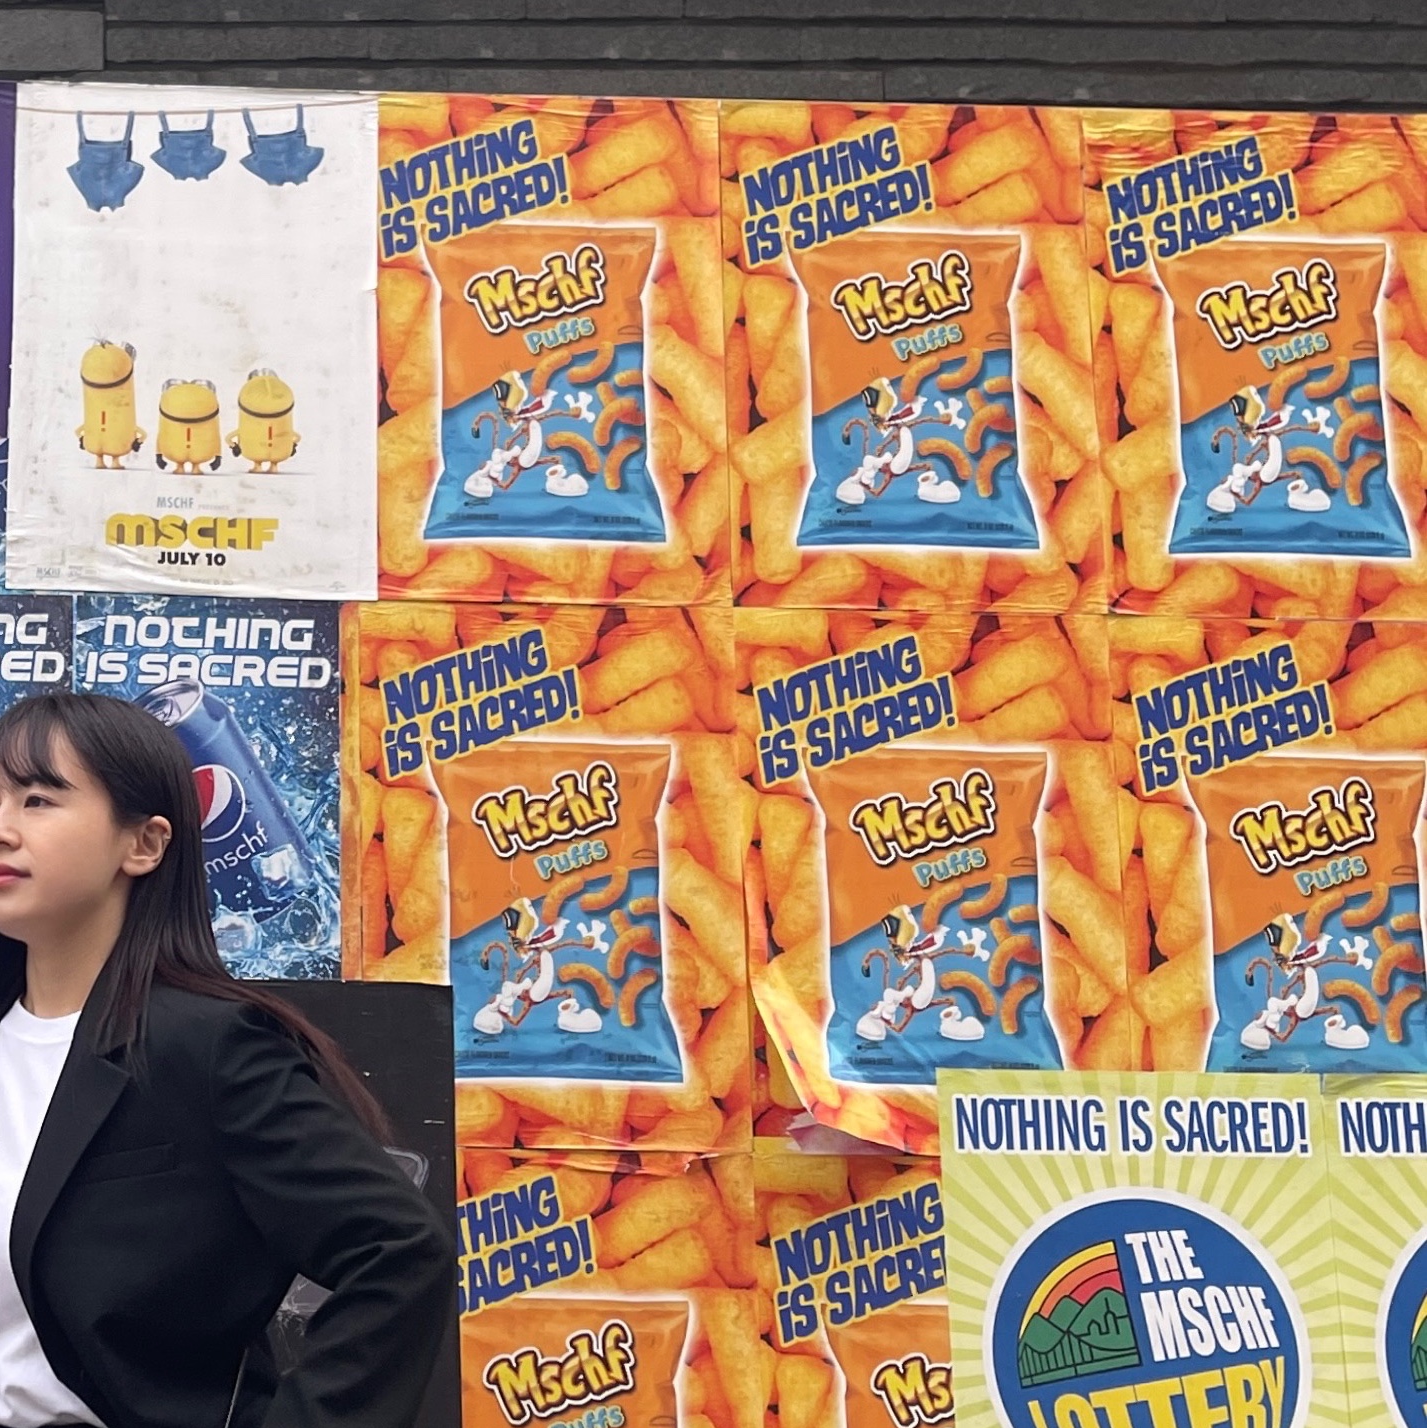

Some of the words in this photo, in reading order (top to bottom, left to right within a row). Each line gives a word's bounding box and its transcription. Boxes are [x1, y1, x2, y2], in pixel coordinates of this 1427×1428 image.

[425, 155, 570, 243] SACRED!
[789, 163, 934, 250] SACRED!
[1153, 174, 1296, 259] SACRED!
[466, 246, 605, 331] Mschf
[833, 253, 971, 337] Mschf
[1198, 260, 1337, 347] Mschf
[525, 317, 596, 355] Puffs
[891, 325, 964, 361] Puffs
[1259, 332, 1330, 369] Puffs
[157, 496, 194, 509] MSCHF
[157, 551, 201, 567] JULY
[205, 553, 227, 567] 10
[84, 651, 127, 685] IS
[137, 652, 332, 689] SACRED
[430, 668, 580, 762] SACRED!
[805, 674, 956, 768] SACRED!
[1184, 682, 1334, 777] SACRED!
[204, 820, 268, 875] mschf
[474, 762, 617, 855] Mschf
[851, 770, 995, 862] Mschf
[1231, 778, 1373, 870] Mschf
[534, 840, 609, 880] Puffs
[913, 847, 987, 887] Puffs
[1294, 855, 1368, 896] Puffs
[955, 1098, 1106, 1152] NOTHING
[1121, 1099, 1153, 1152] IS
[1165, 1101, 1310, 1155] SACRED!
[1125, 1230, 1204, 1284] THE
[1140, 1286, 1280, 1363] MSCHF
[485, 1321, 634, 1422] Mschf
